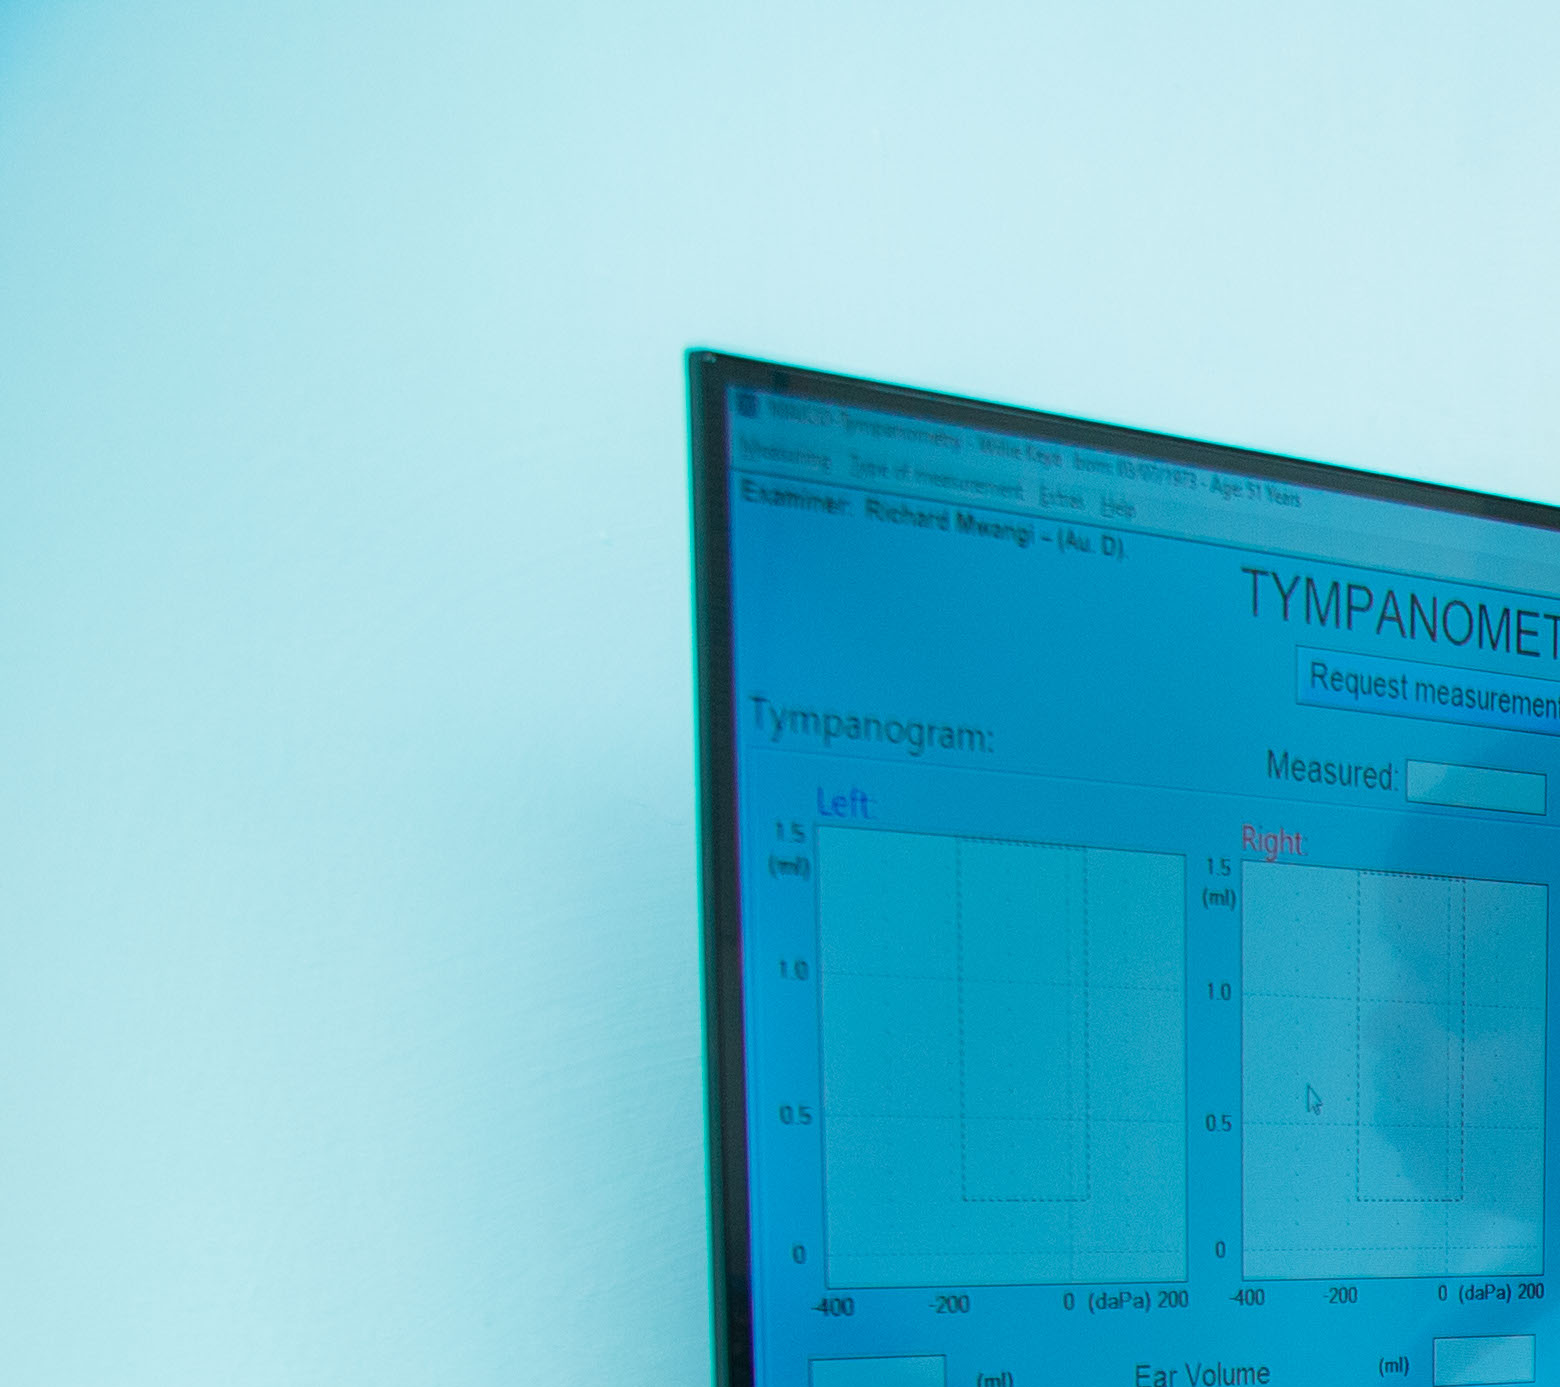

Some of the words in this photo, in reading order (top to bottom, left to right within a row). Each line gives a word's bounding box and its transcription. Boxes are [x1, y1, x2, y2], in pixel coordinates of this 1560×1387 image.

[865, 496, 949, 532] Richard
[955, 511, 1036, 550] Mwangi
[1309, 661, 1409, 704] Request
[749, 694, 995, 758] Tympanogram:
[1266, 748, 1400, 792] Measured:
[1241, 823, 1308, 863] Right:
[1206, 857, 1232, 877] 1.5
[1201, 887, 1237, 911] (ml)
[777, 960, 810, 981] 1.0
[1206, 982, 1232, 1002] 1.0
[778, 1105, 813, 1126] 0.5
[1205, 1114, 1233, 1133] 0.5
[791, 1245, 808, 1266] 0
[1215, 1240, 1227, 1259] 0
[928, 1294, 971, 1316] -200
[1062, 1291, 1076, 1312] 0
[1088, 1290, 1152, 1315] (daPa)
[1157, 1290, 1190, 1310] 200
[1322, 1286, 1359, 1306] -200
[1437, 1283, 1449, 1302] 0
[1458, 1282, 1513, 1305] (daPa)
[1517, 1281, 1546, 1301] 200
[1377, 1356, 1411, 1378] (ml)
